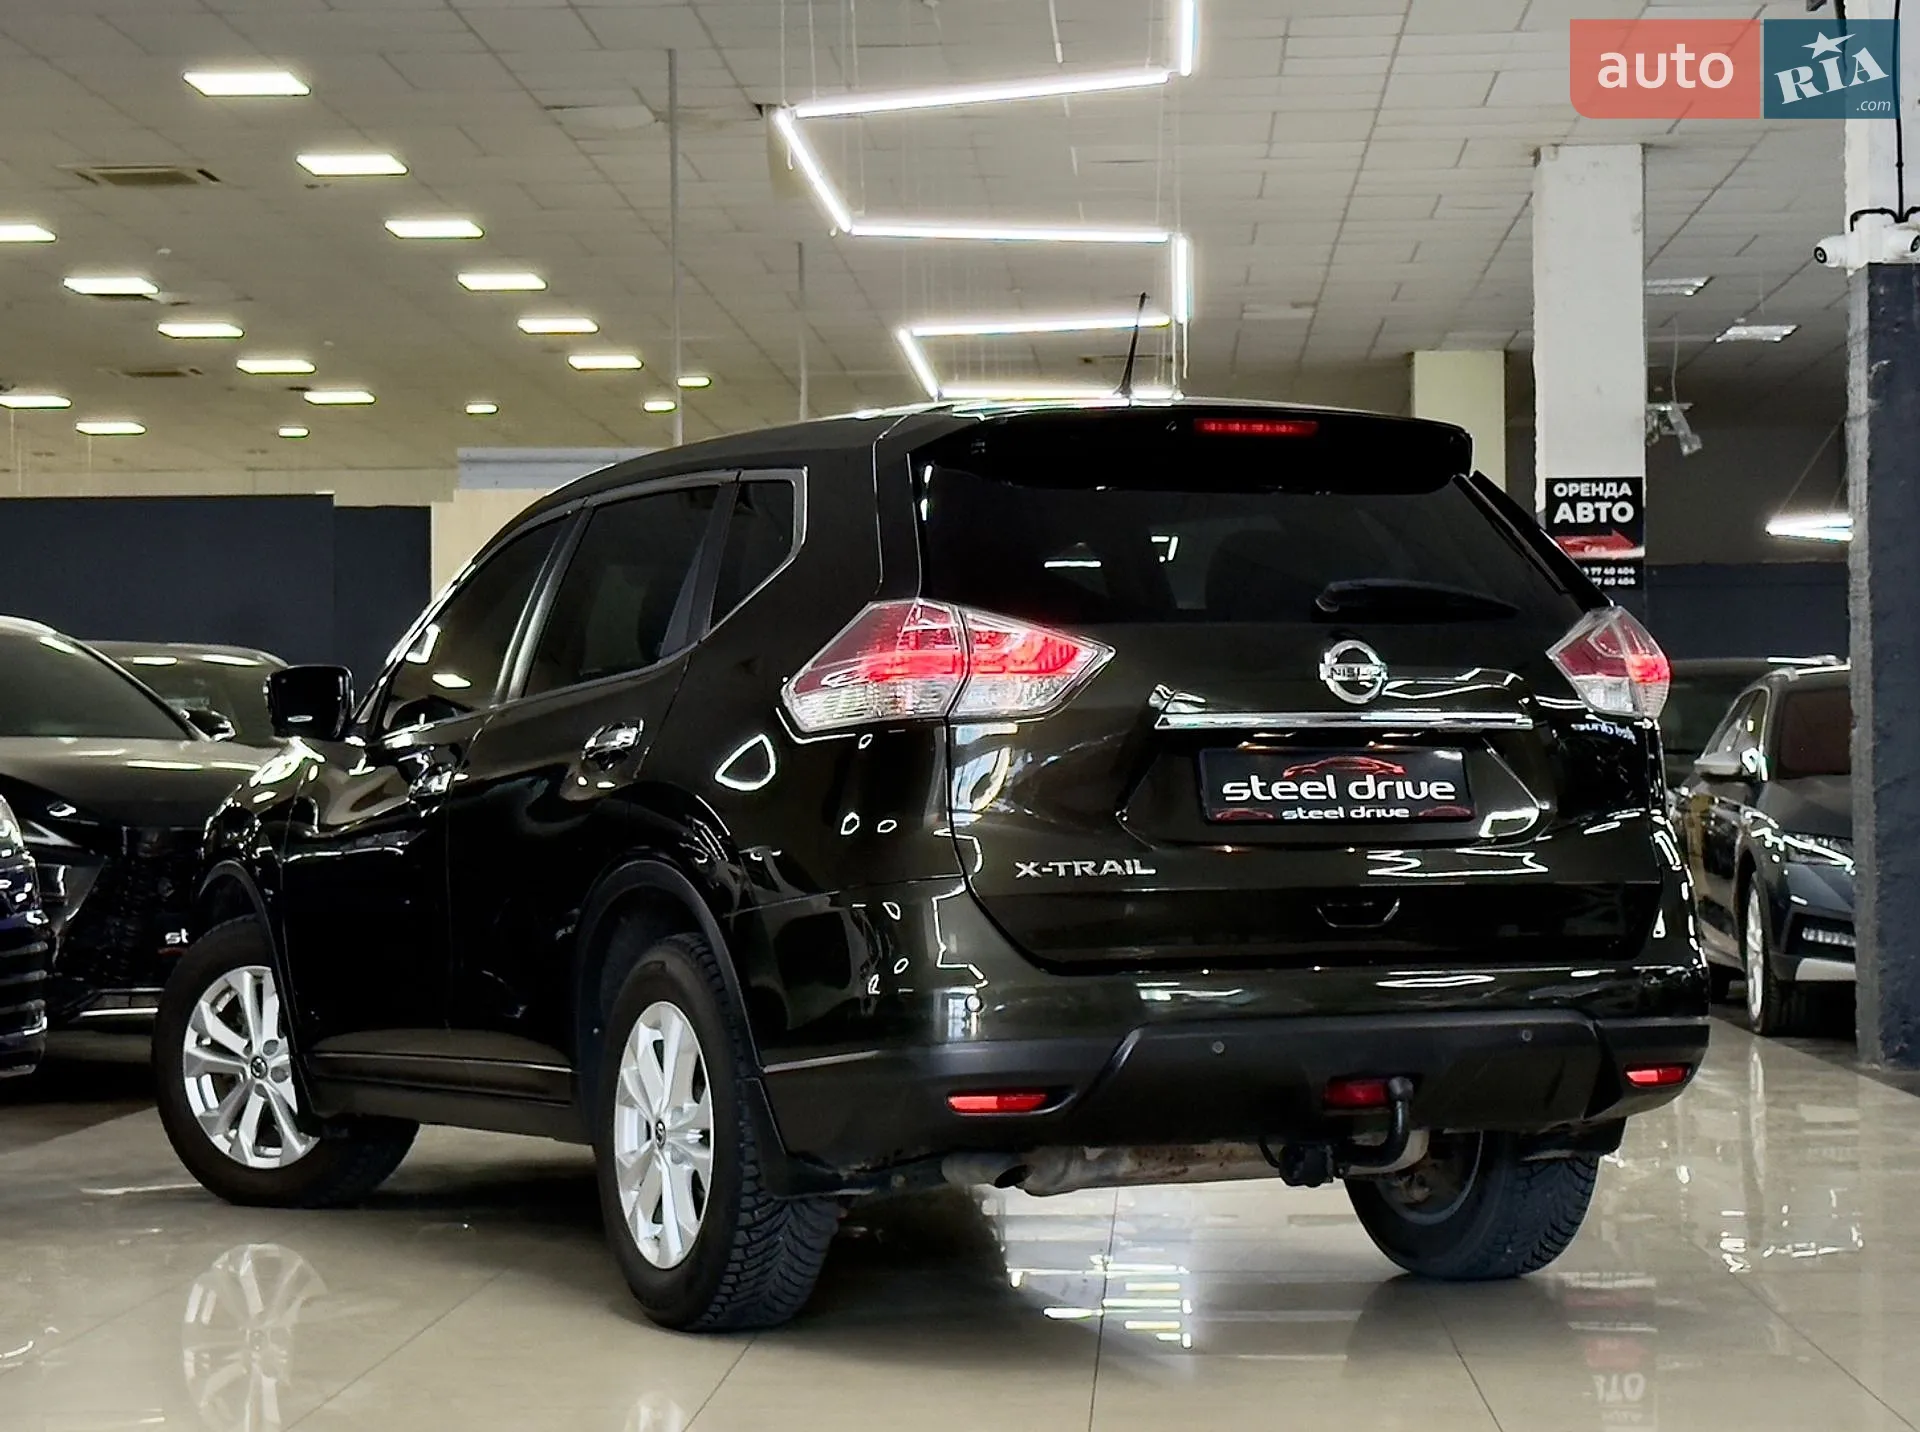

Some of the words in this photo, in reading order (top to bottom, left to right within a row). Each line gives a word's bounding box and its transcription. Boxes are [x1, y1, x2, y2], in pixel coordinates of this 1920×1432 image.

[1553, 482, 1632, 498] ОРЕНДА
[1553, 501, 1634, 524] АВТО
[1222, 774, 1337, 801] steel
[1349, 774, 1456, 801] drive
[1281, 805, 1345, 820] steel
[1349, 804, 1410, 819] drive
[1014, 858, 1157, 878] X-TRAIL
[164, 928, 190, 945] st
